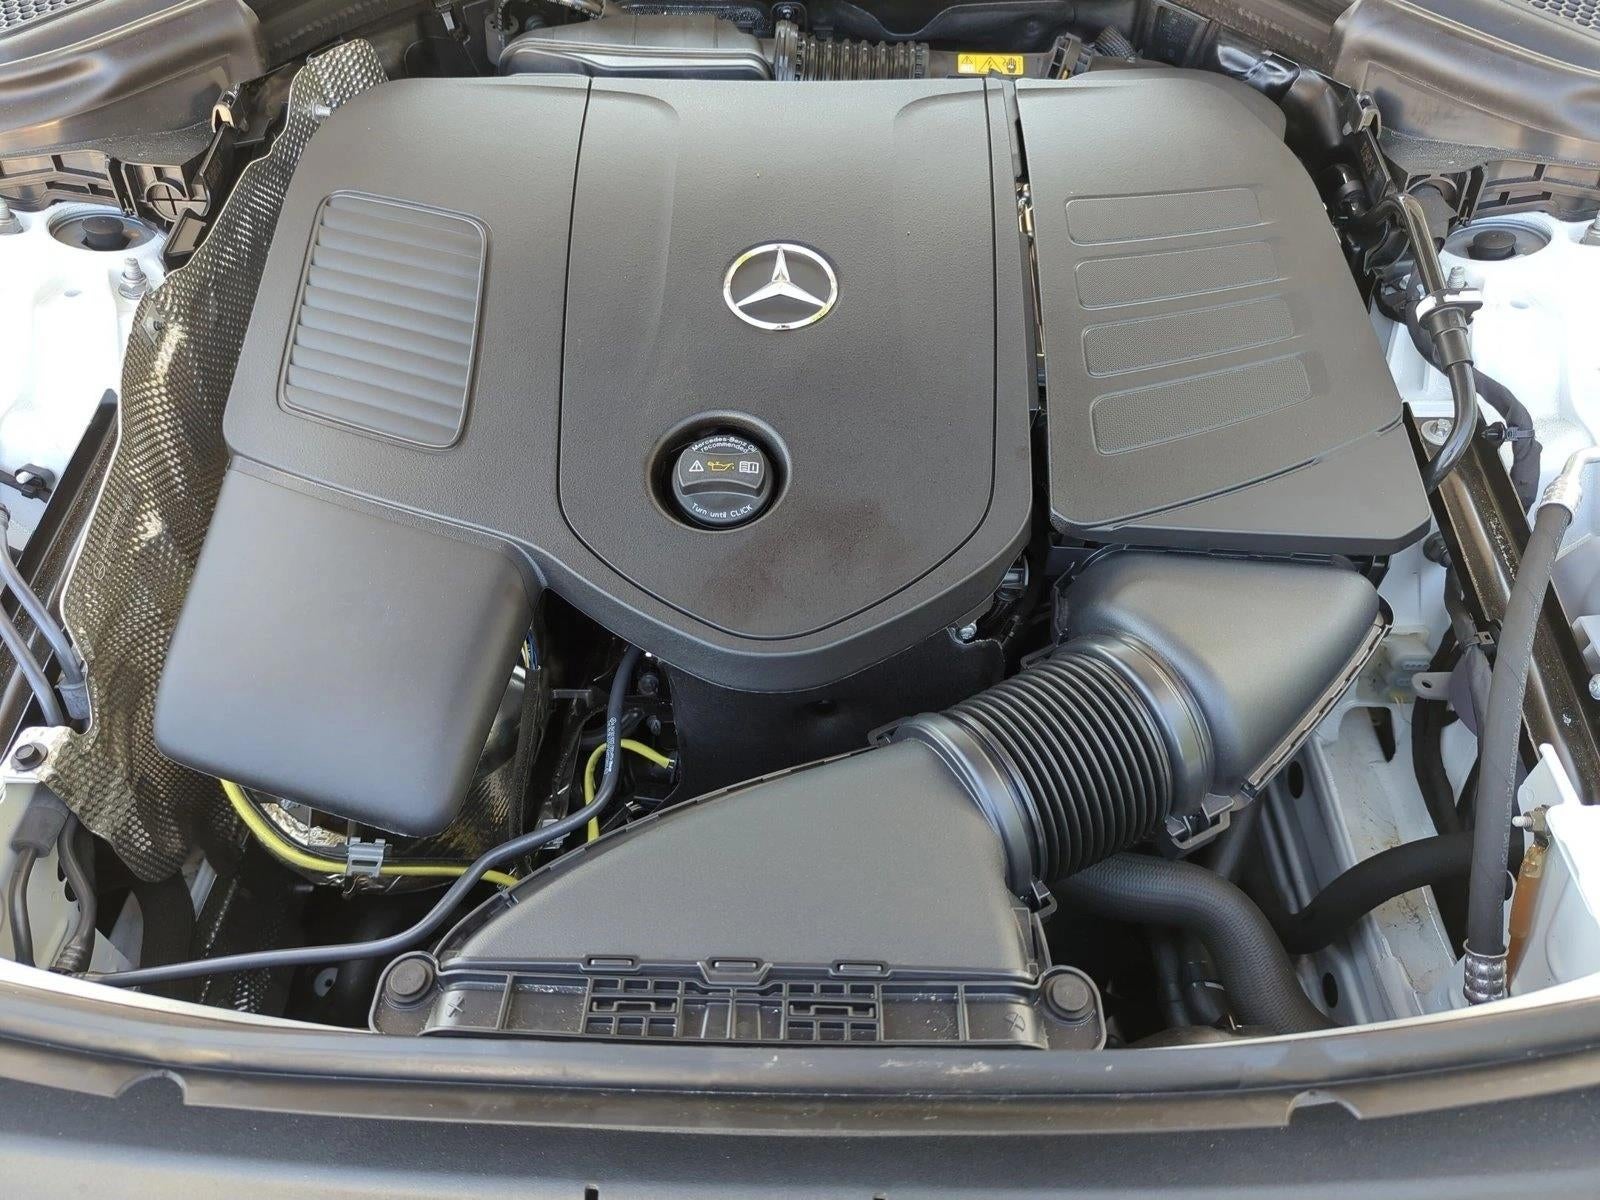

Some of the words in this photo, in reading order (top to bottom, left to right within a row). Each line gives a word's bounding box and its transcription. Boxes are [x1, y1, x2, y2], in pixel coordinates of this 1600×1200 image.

[700, 441, 748, 453] recommended
[691, 502, 707, 515] Turn
[730, 503, 752, 517] CLICK
